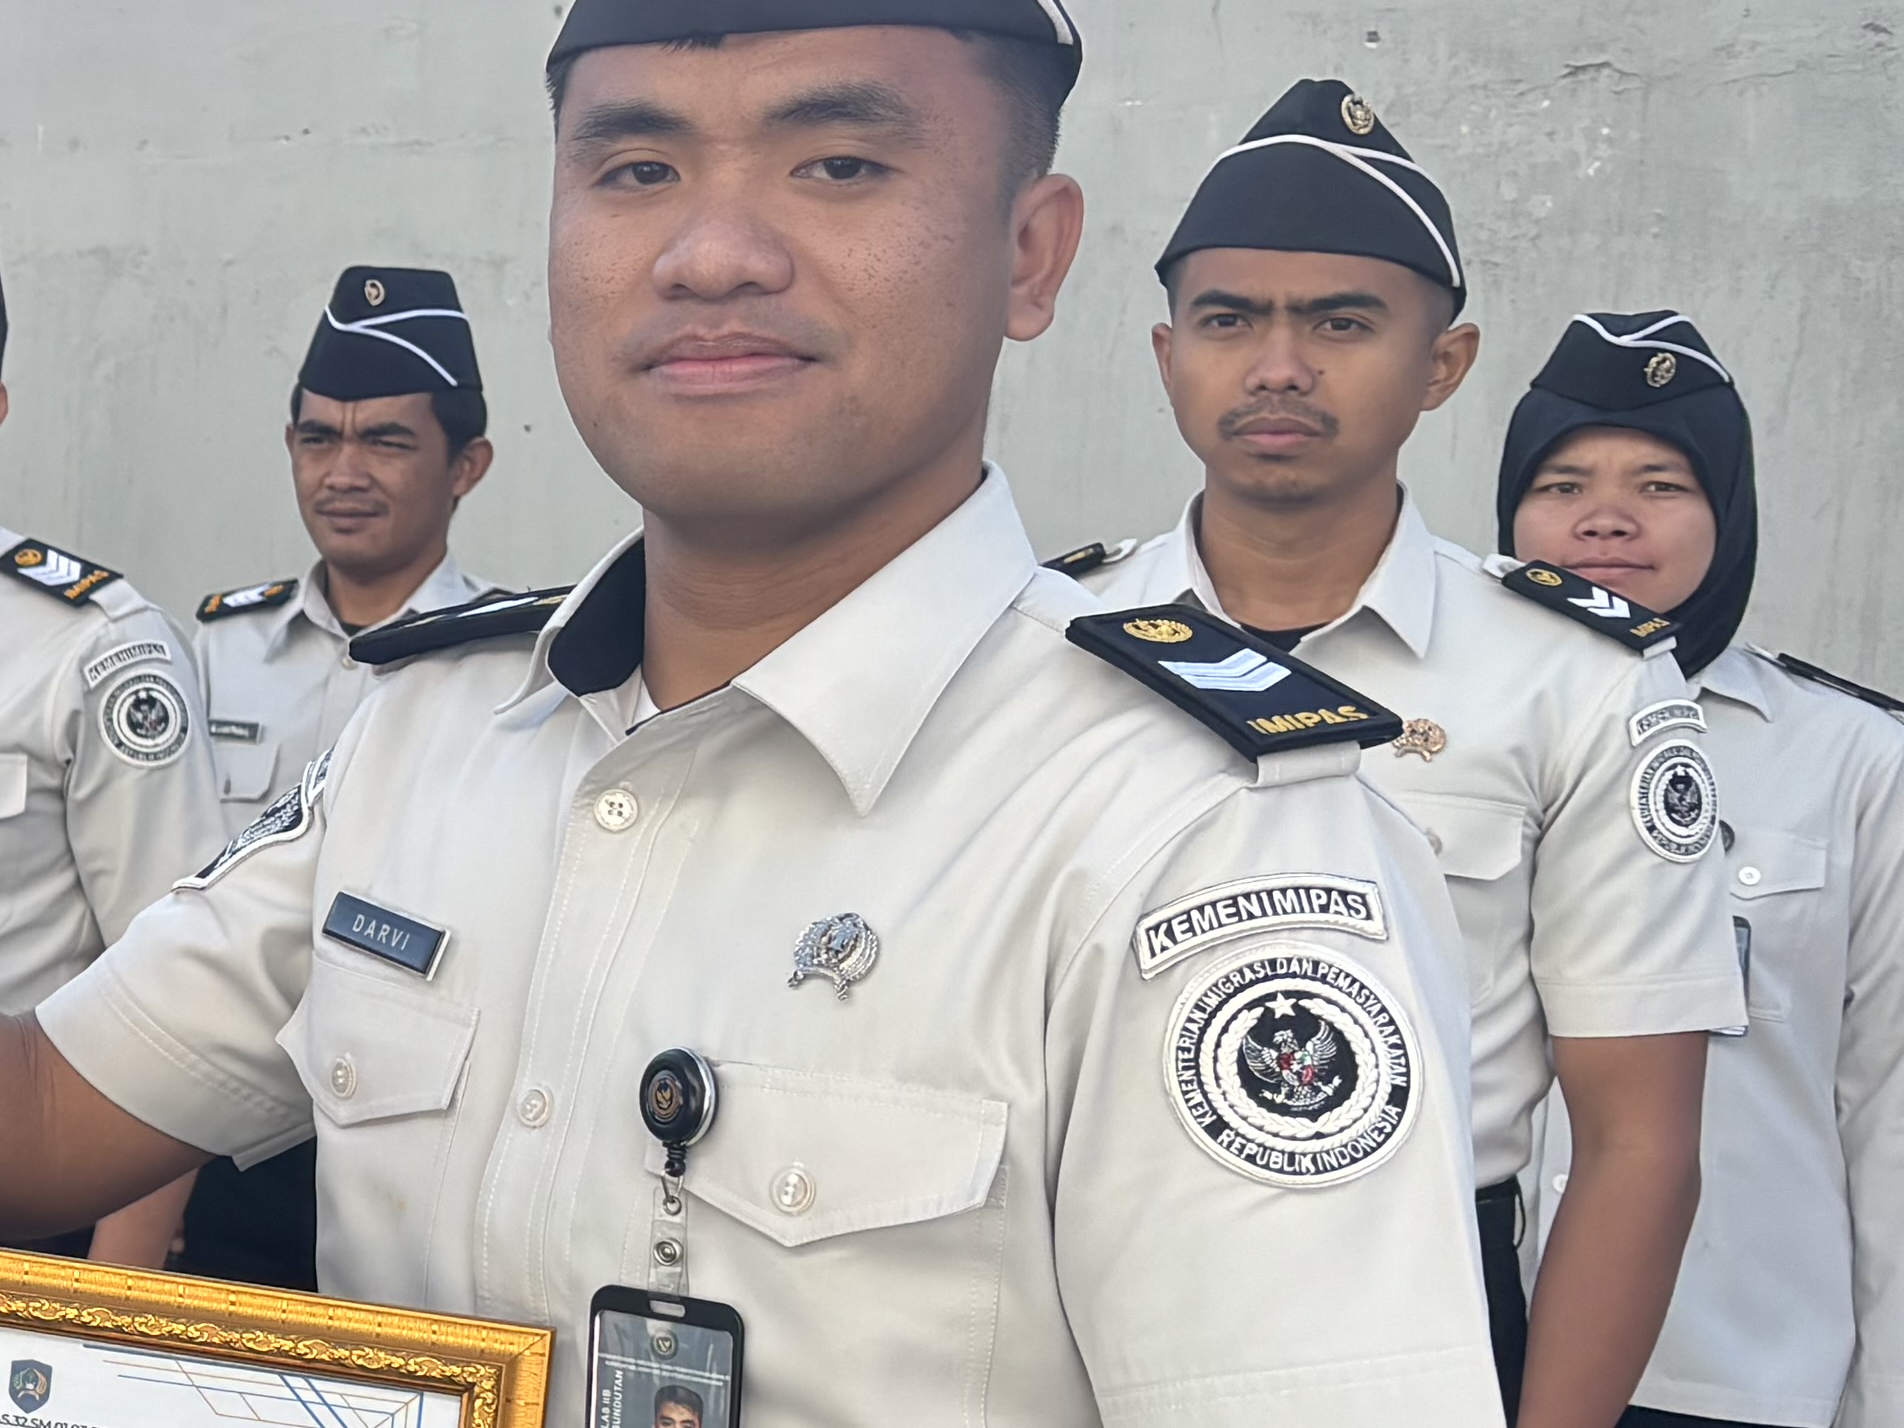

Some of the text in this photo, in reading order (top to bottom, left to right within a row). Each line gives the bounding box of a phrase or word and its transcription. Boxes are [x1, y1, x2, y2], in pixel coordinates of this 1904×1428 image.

[1246, 705, 1369, 735] IMIPAS
[352, 913, 410, 951] DARVI
[1148, 888, 1368, 957] KEMENIMIPAS
[1200, 961, 1272, 1014] IMIGRASI
[1276, 956, 1315, 976] DAN
[1217, 1104, 1402, 1174] REPUBLIK INDONESIA
